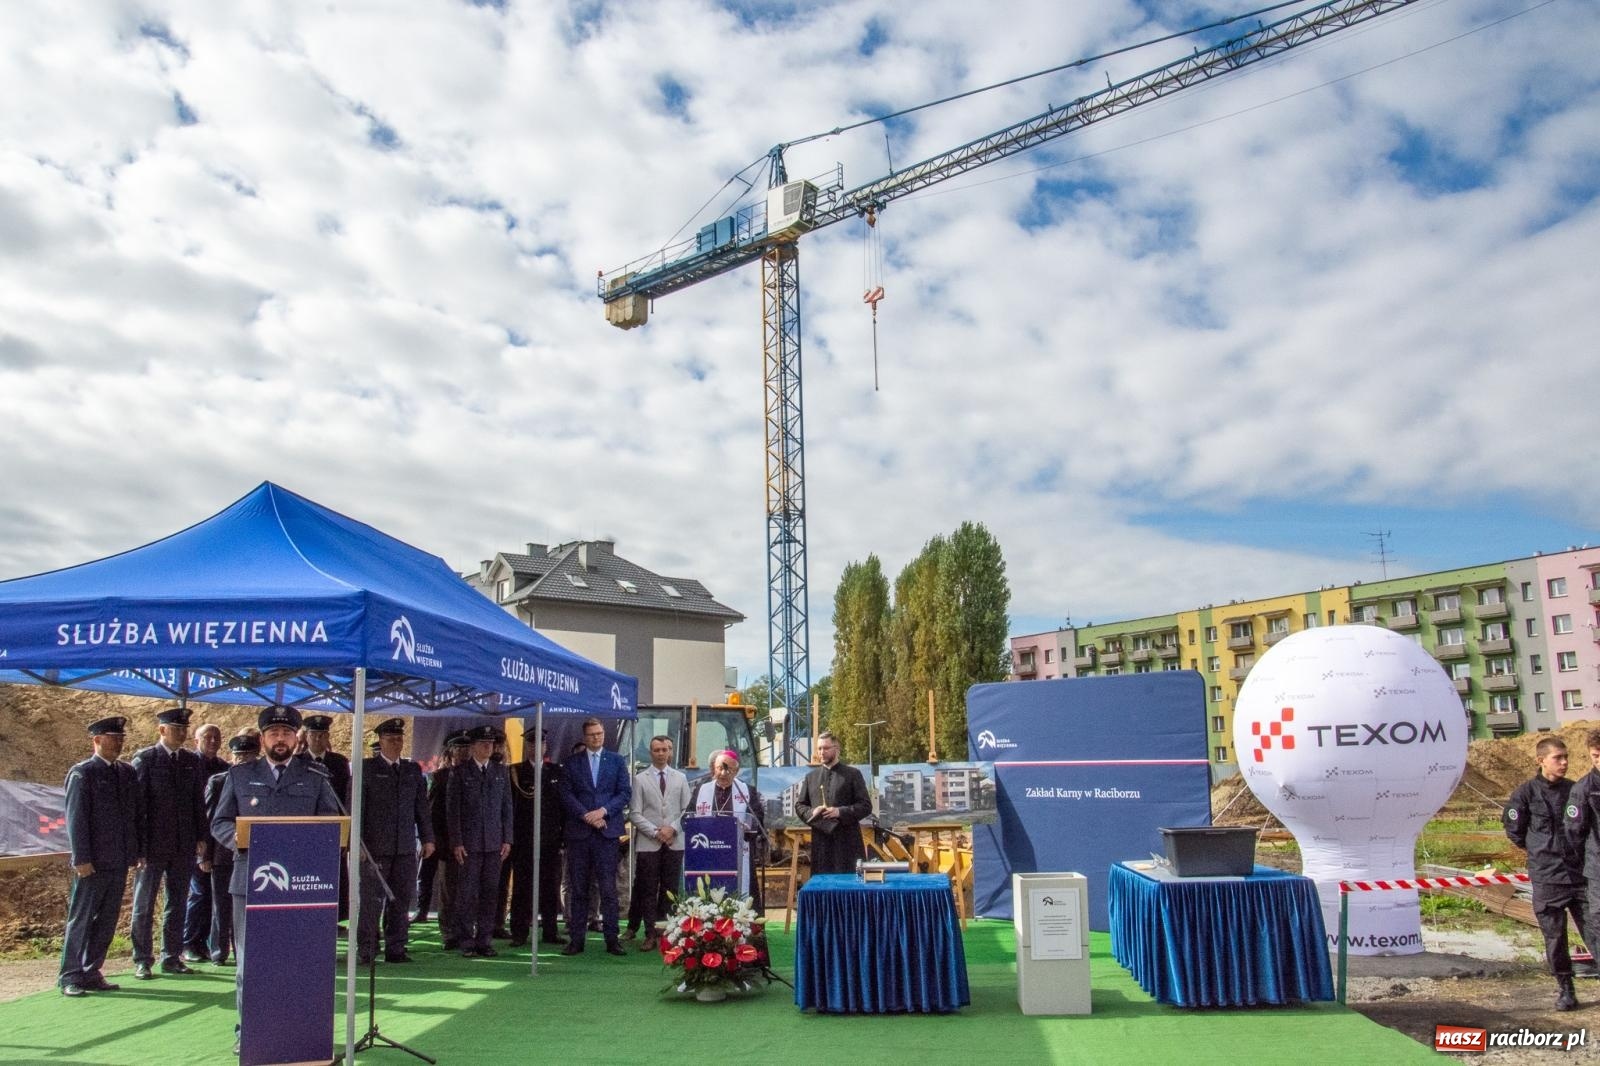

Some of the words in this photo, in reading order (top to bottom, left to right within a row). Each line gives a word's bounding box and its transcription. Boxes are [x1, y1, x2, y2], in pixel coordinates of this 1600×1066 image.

[57, 617, 158, 646] SŁUŻBA
[168, 620, 329, 649] WIĘZIENNA
[416, 642, 434, 654] SŁUŻBA
[416, 656, 443, 669] WIĘZIENNA
[501, 657, 535, 684] SŁUŻBA
[536, 667, 580, 695] WIĘZIENNA
[1307, 719, 1447, 747] TEXOM
[1341, 768, 1374, 776] TEXOM
[1025, 787, 1055, 799] Zakład
[1056, 788, 1082, 800] Karny
[1094, 787, 1141, 799] Raciborzu
[1392, 791, 1420, 799] TEXOM
[291, 875, 321, 883] SŁUŻBA
[291, 883, 334, 891] WIĘZIENNA
